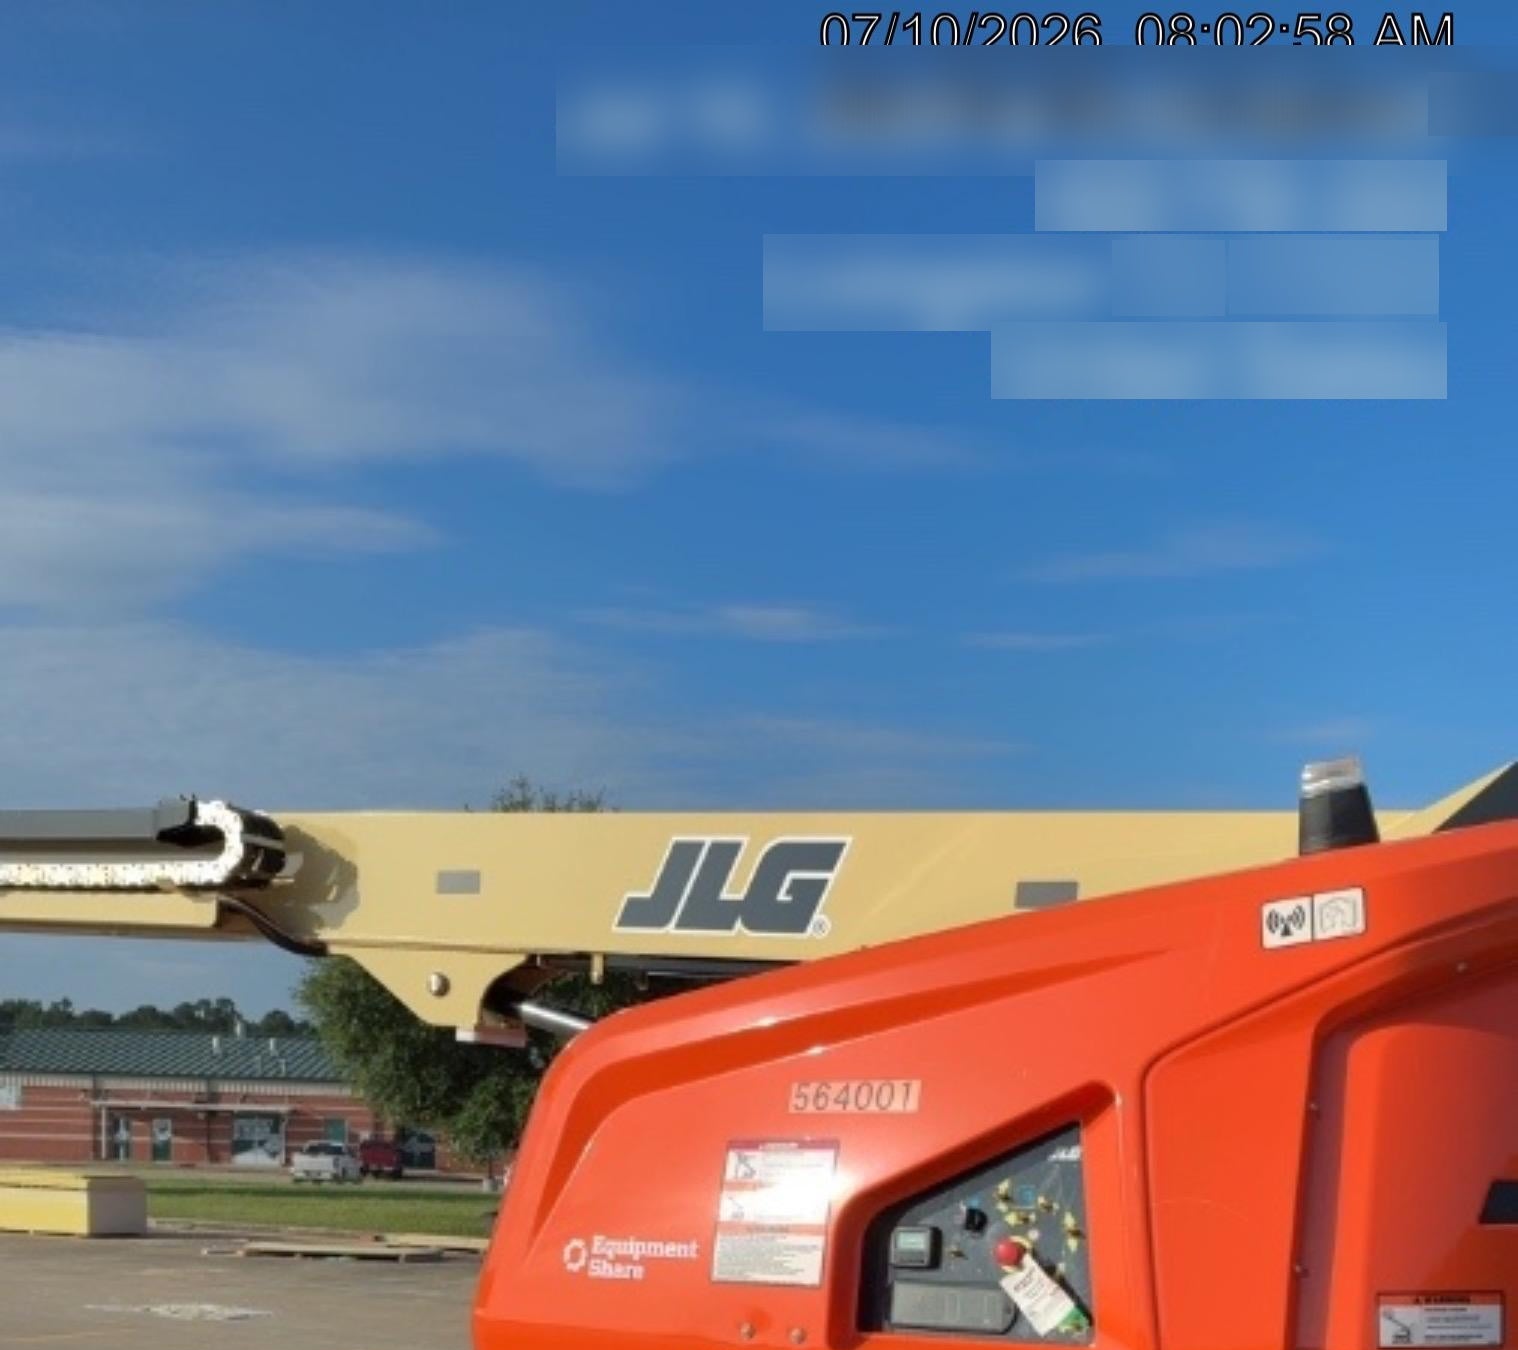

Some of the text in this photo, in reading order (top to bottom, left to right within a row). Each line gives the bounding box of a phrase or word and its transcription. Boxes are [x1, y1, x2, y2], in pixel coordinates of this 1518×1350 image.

[612, 836, 852, 937] JLG
[793, 1081, 912, 1111] 564001
[592, 1235, 699, 1261] Equipment
